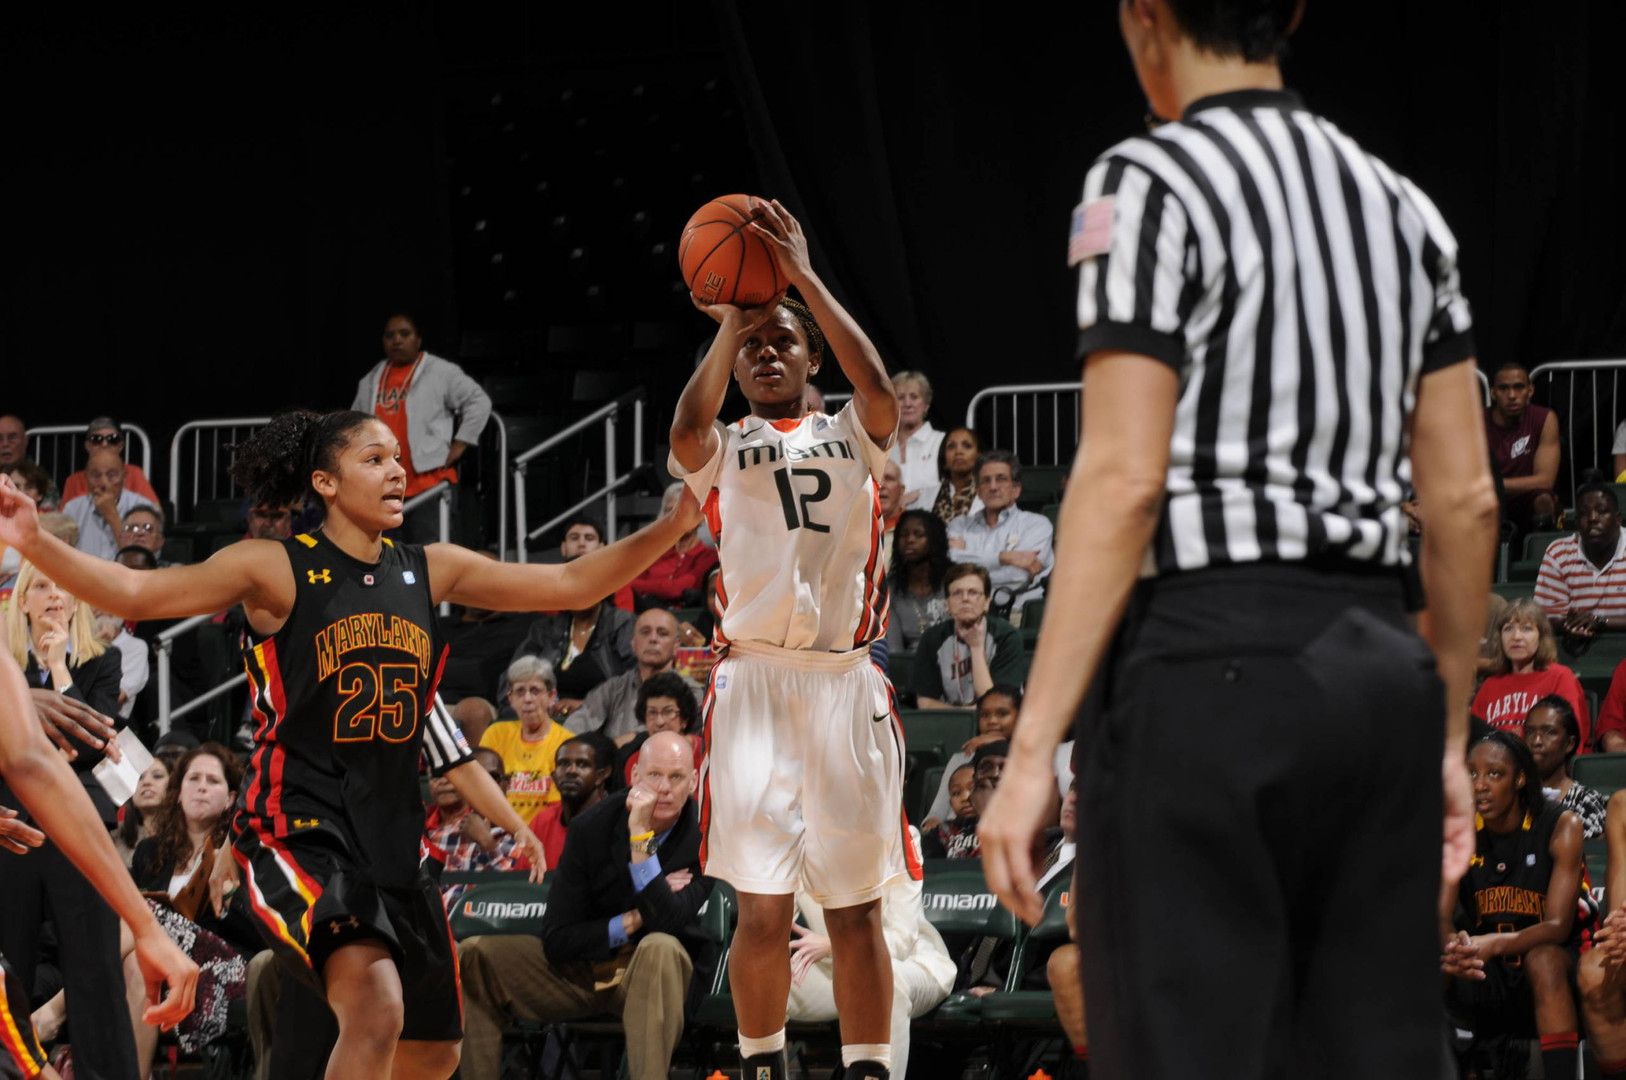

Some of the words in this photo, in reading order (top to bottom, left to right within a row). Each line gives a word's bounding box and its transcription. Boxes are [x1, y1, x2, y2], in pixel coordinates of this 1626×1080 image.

[774, 468, 832, 531] 12
[315, 613, 431, 682] MARYLAND
[333, 662, 418, 743] 25
